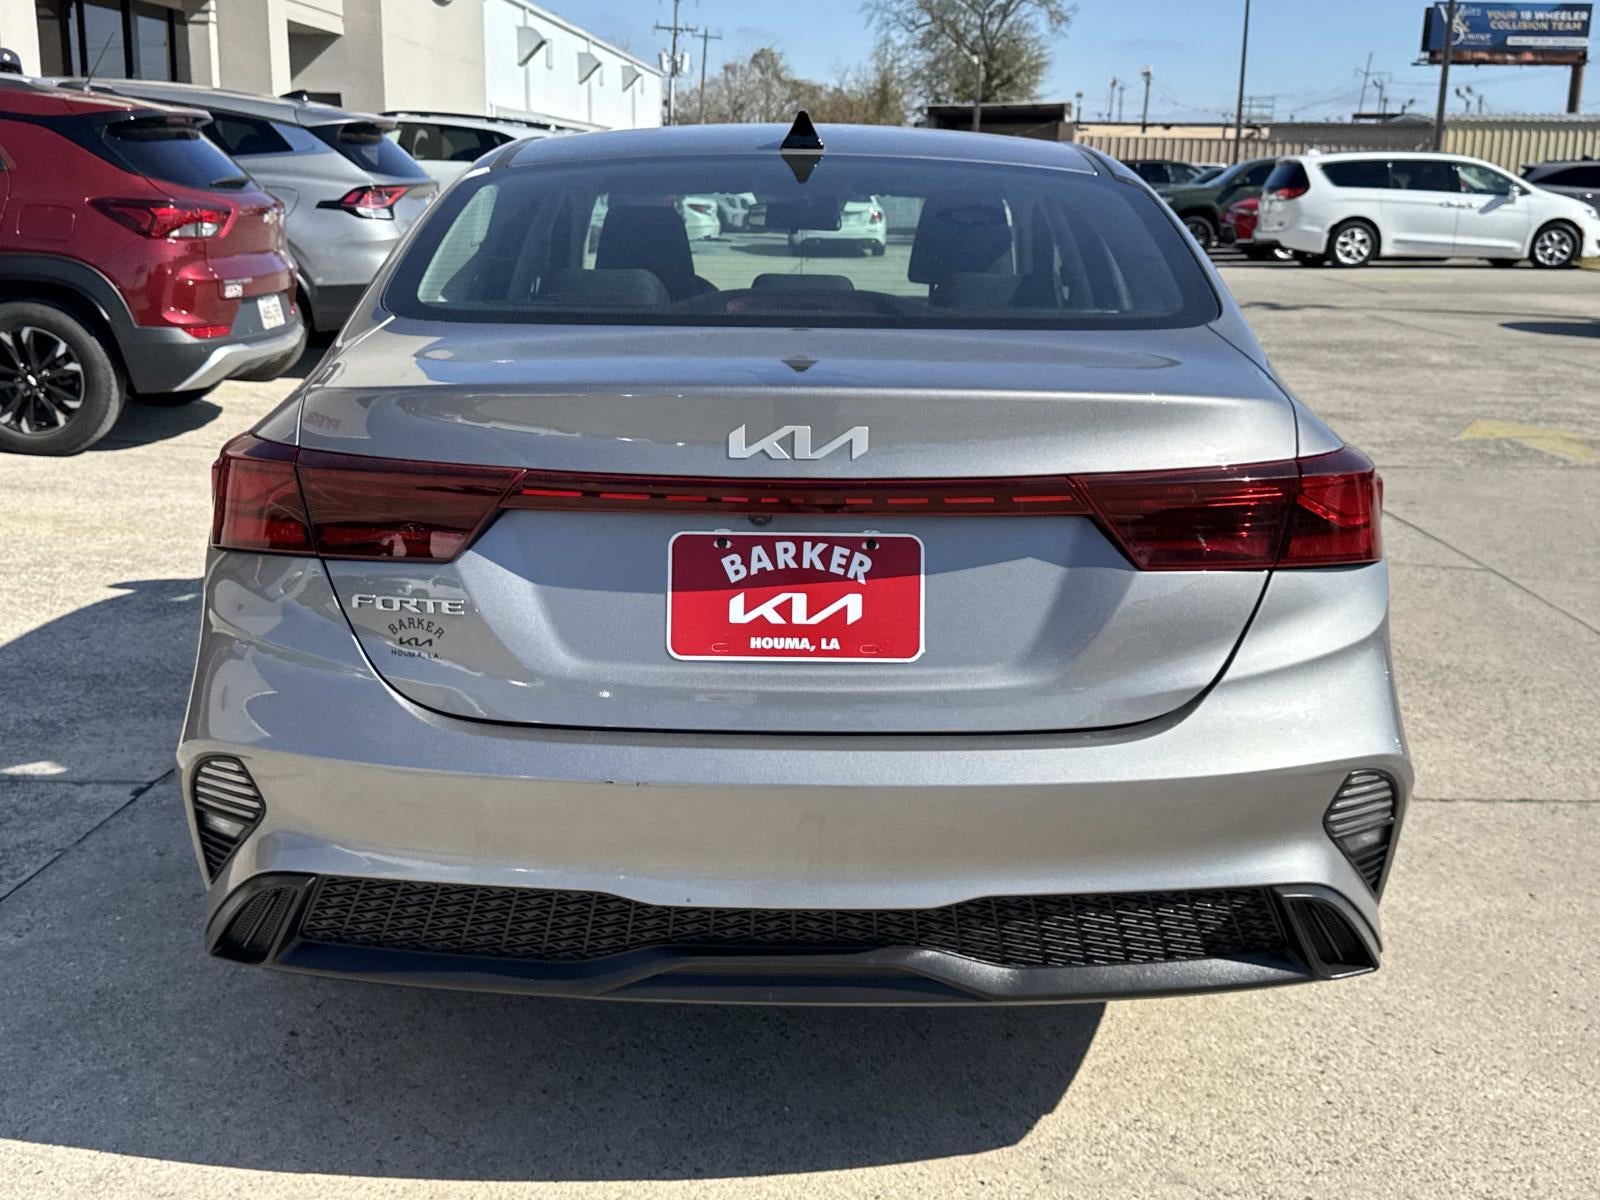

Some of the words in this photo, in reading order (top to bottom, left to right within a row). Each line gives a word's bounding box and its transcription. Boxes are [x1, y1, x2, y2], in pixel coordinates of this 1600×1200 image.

[1487, 10, 1518, 19] YOUR
[1520, 11, 1532, 20] 18
[1534, 10, 1588, 21] WHEELER
[1490, 20, 1549, 30] COLLISION
[1551, 21, 1582, 31] TEAM
[728, 424, 869, 460] KIA
[720, 541, 873, 585] BARKER
[351, 594, 465, 615] FORTE
[728, 592, 863, 625] KIA
[388, 617, 444, 639] BARKER
[399, 637, 433, 647] KIA
[750, 637, 815, 652] HOUMA,
[820, 637, 840, 650] LA
